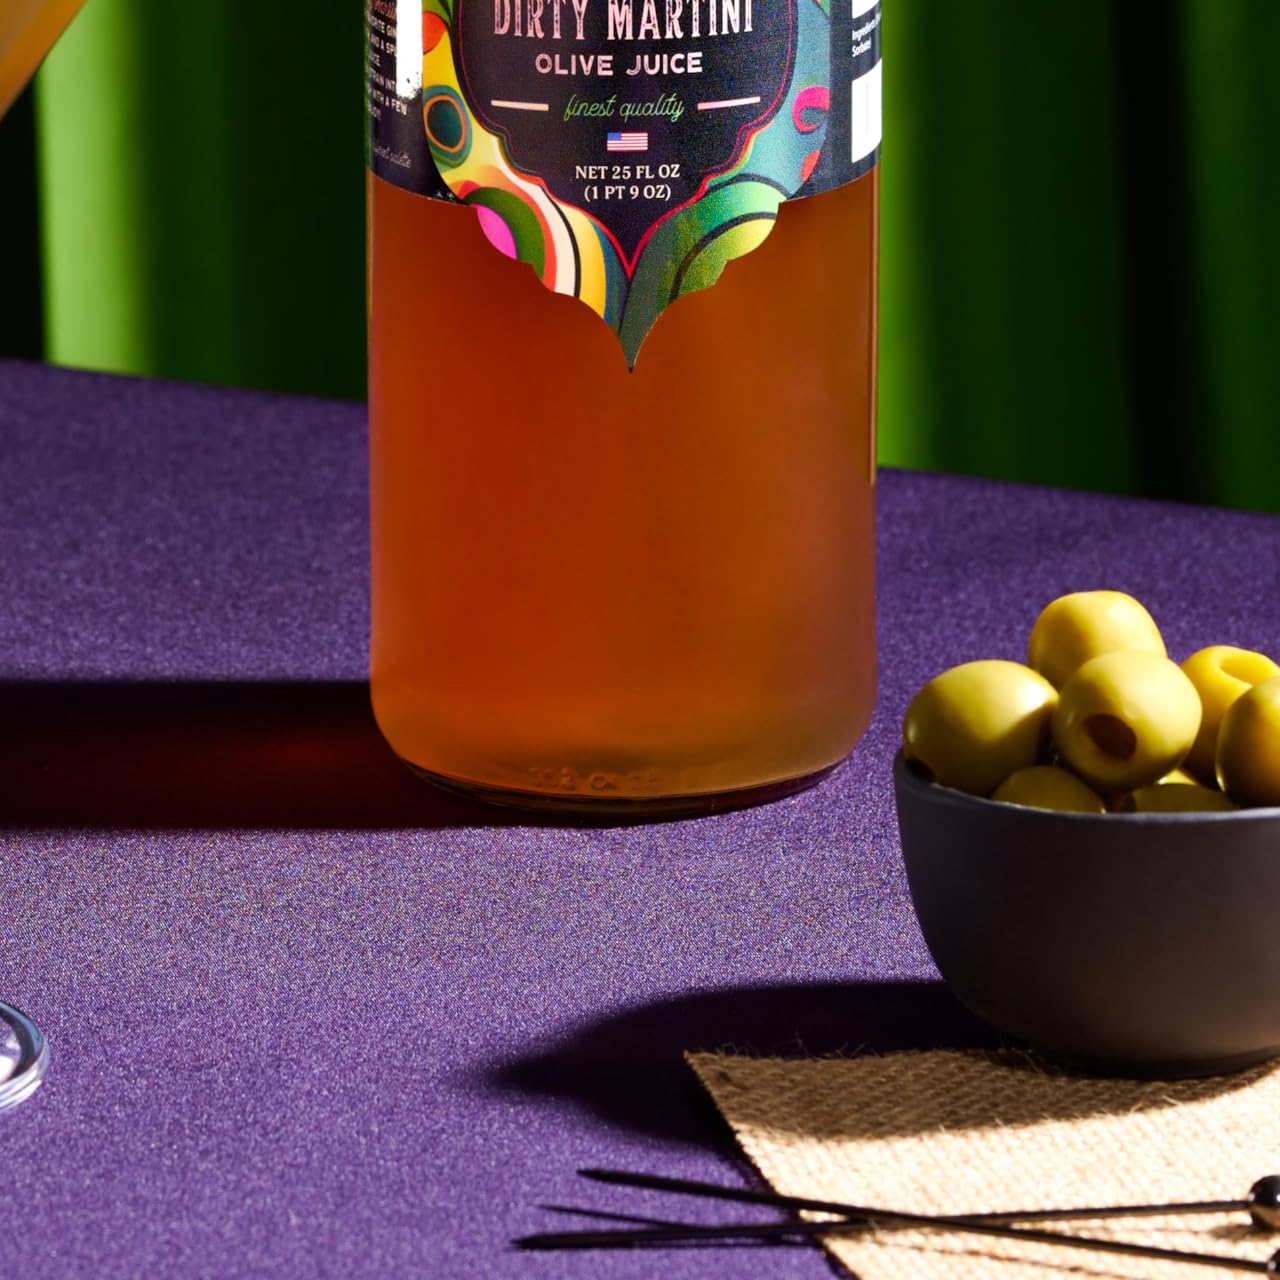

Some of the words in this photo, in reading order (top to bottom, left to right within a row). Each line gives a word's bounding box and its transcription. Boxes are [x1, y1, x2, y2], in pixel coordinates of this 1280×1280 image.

[534, 53, 614, 76] OLIVE
[626, 51, 704, 75] JUICE
[391, 98, 408, 116] FEW
[563, 93, 617, 122] finest
[619, 92, 685, 122] quality
[575, 165, 608, 180] NET
[612, 165, 631, 180] 25
[636, 166, 655, 180] FL
[658, 163, 681, 179] OZ
[584, 184, 599, 202] (1
[605, 186, 626, 200] PT
[630, 185, 640, 200] 9
[643, 183, 672, 202] OZ)
